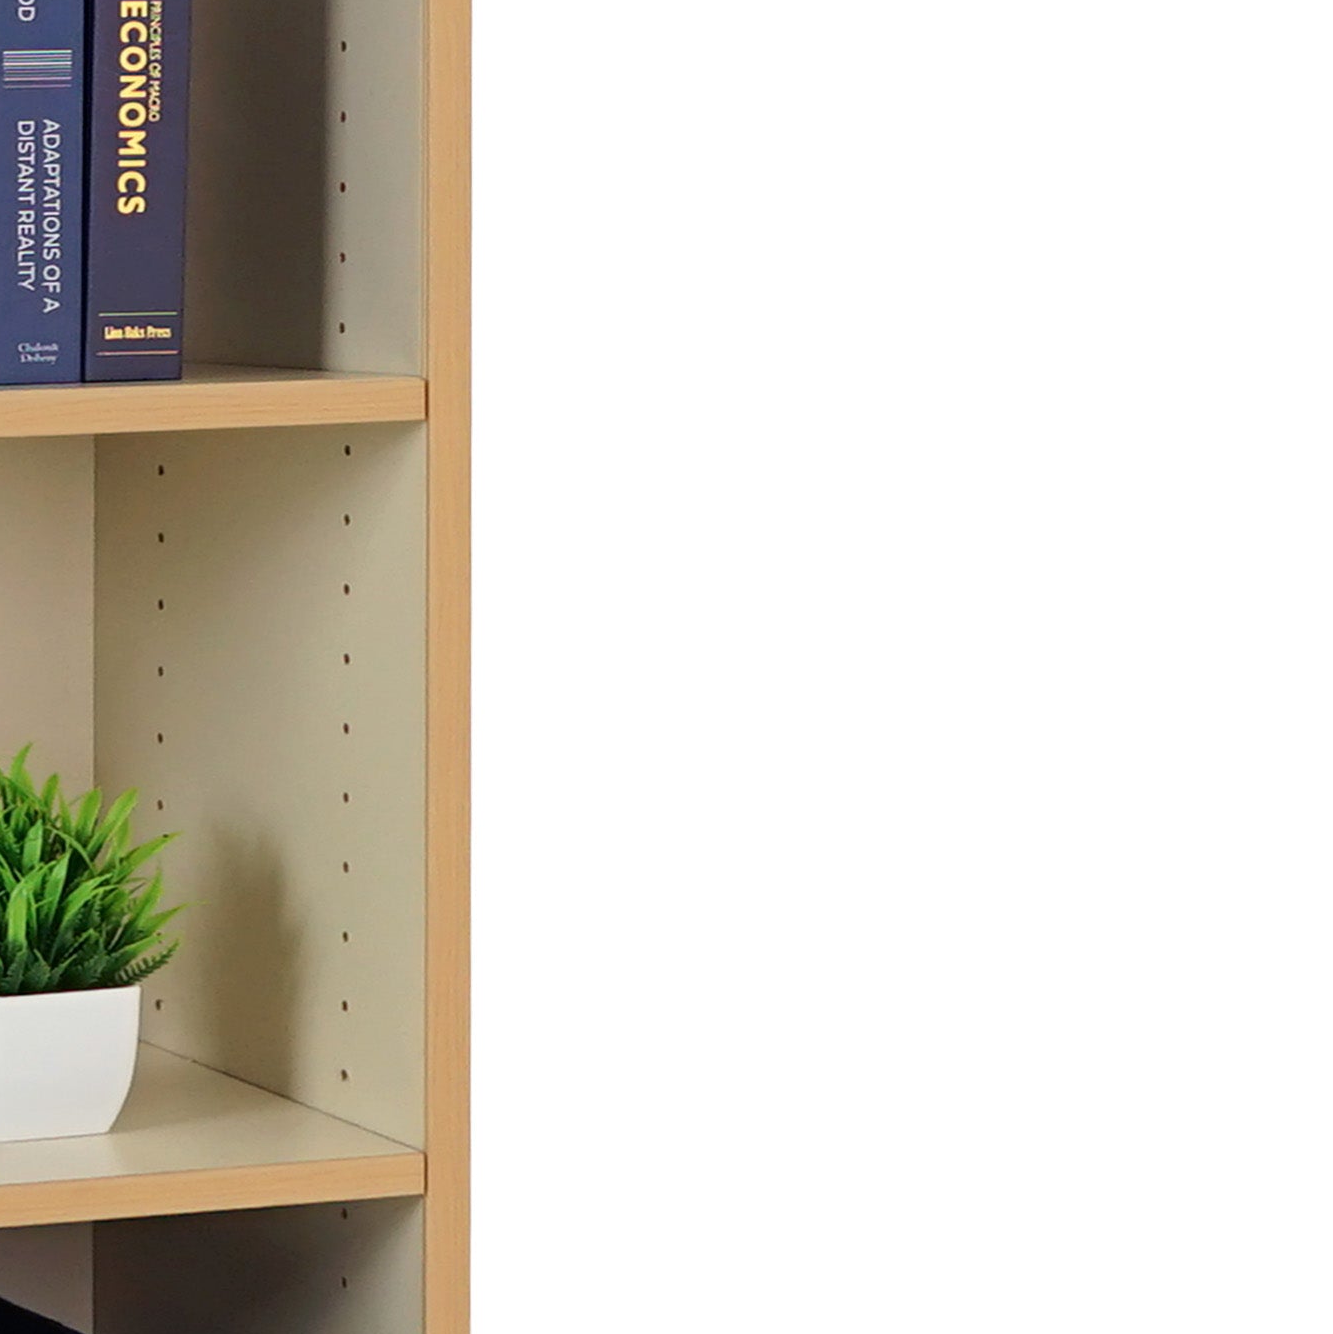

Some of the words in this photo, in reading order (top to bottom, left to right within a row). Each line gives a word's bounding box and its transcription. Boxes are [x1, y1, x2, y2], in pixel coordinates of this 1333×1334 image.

[149, 1, 162, 61] PRINCIPLES
[149, 62, 162, 78] OF
[117, 0, 148, 214] ECONOMICS
[148, 80, 162, 122] MACRO
[17, 120, 35, 205] DISTANT
[42, 119, 61, 260] ADAPTATIONS
[17, 210, 35, 291] REALITY
[42, 265, 61, 293] OF
[42, 297, 61, 313] A
